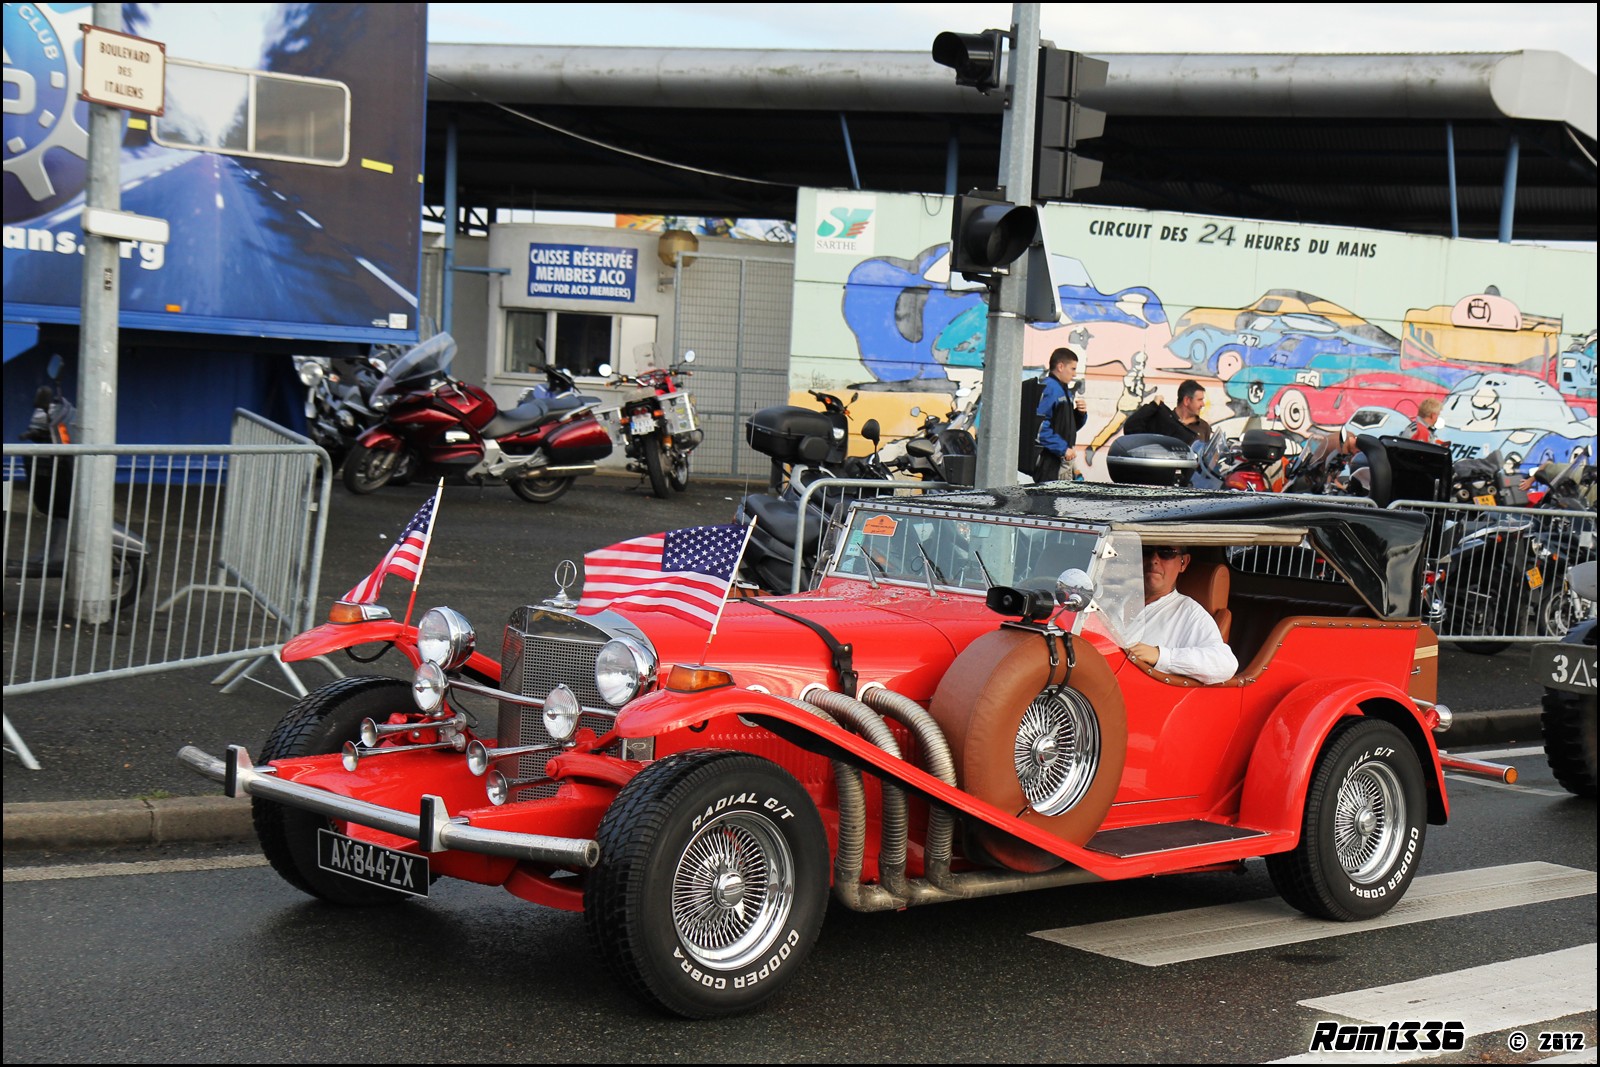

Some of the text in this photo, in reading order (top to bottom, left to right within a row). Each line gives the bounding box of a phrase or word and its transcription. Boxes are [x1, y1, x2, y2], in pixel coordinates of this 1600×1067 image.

[18, 5, 60, 60] CLUB
[99, 41, 150, 64] BOULEVARD
[117, 65, 133, 78] DES
[104, 80, 144, 99] ITALIENS
[816, 240, 857, 250] SARTHE
[1089, 220, 1377, 258] CIRCUIT DES 24 HEURES DU MANS
[530, 247, 633, 269] CAISSE RÉSERVÉE
[535, 266, 626, 285] MEMBRES ACO
[530, 282, 631, 300] (ONLY FOR ACO MEMBERS)
[1374, 747, 1395, 757] G/T
[692, 793, 794, 832] RADIAL G/T
[1350, 826, 1419, 899] COOPER COBRA
[673, 929, 800, 990] COOPER COBRA
